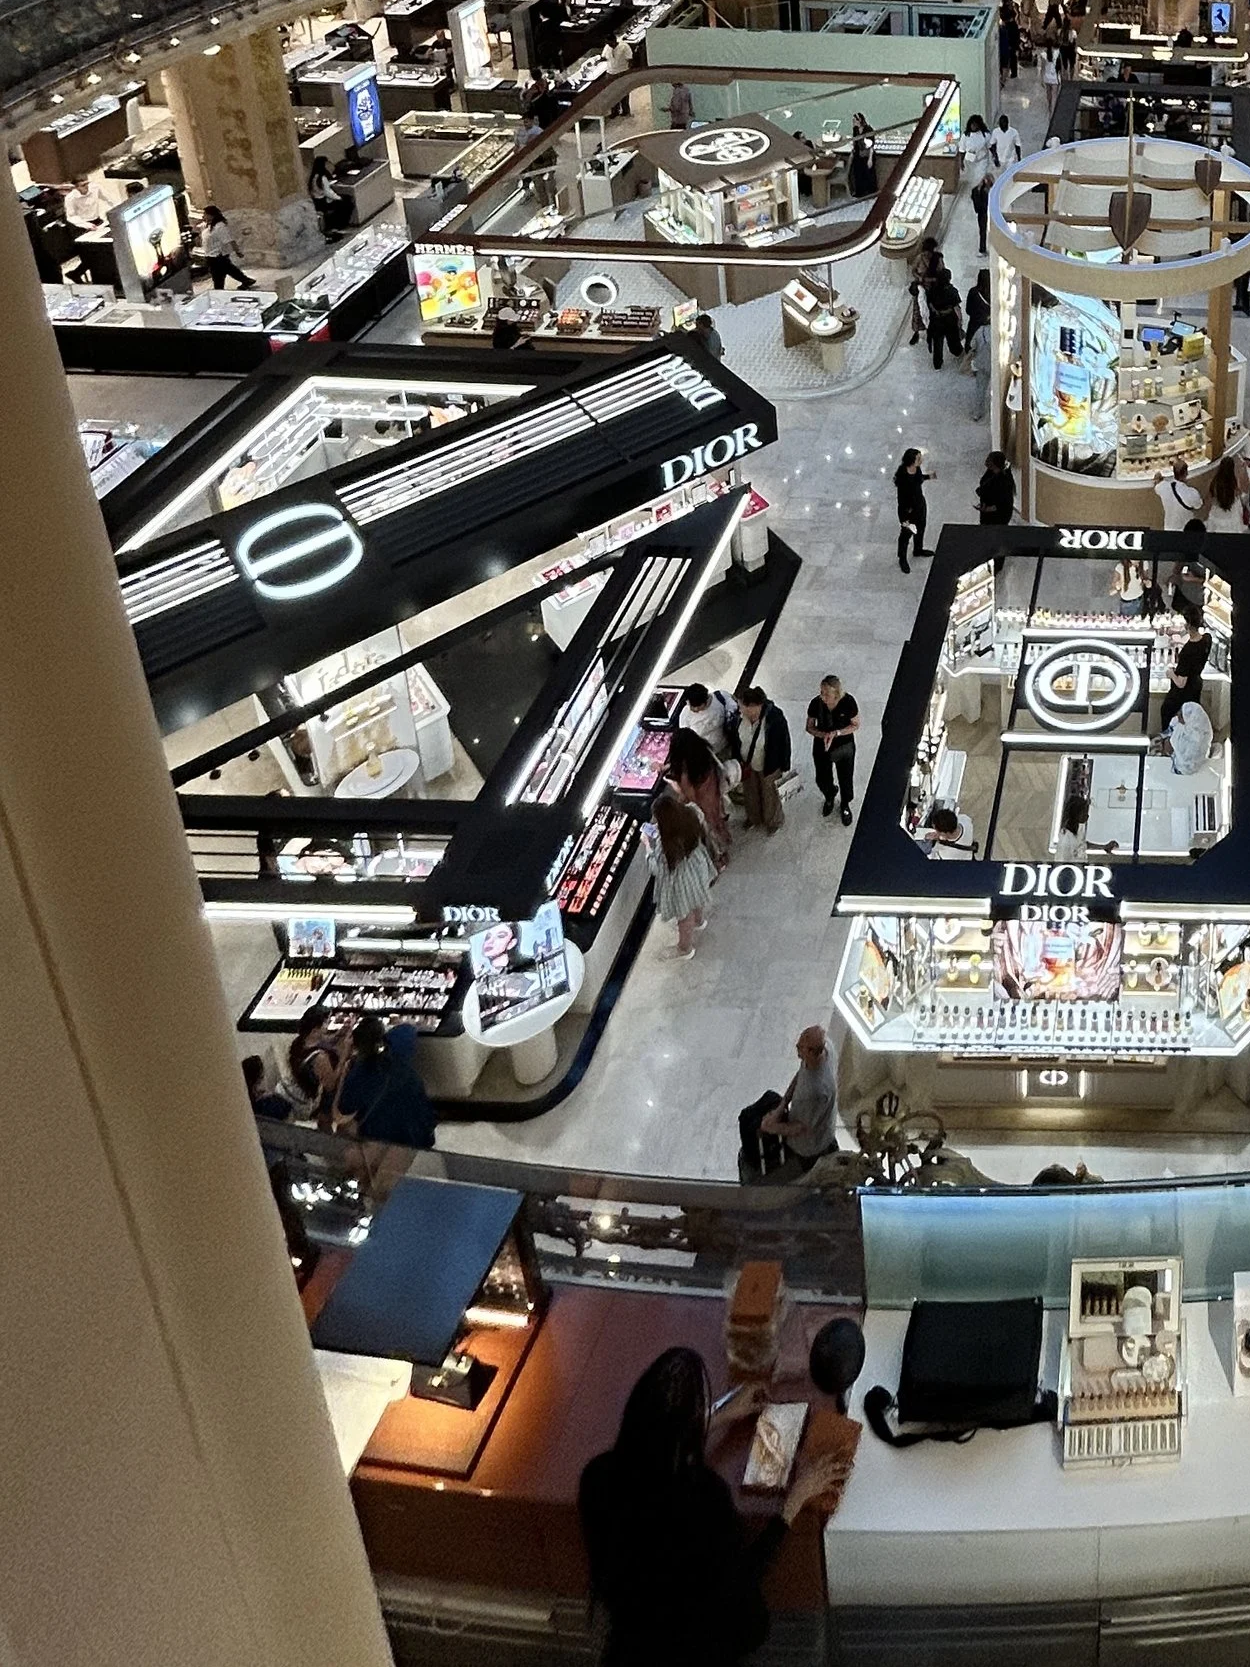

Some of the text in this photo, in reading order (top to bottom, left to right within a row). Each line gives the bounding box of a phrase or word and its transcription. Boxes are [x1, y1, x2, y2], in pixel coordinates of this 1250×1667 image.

[658, 356, 727, 411] DIOR
[660, 422, 763, 491] DIOR
[1059, 528, 1145, 551] DIOR
[999, 863, 1115, 898] DIOR
[442, 904, 502, 922] DIOR
[1020, 904, 1091, 923] DIOR
